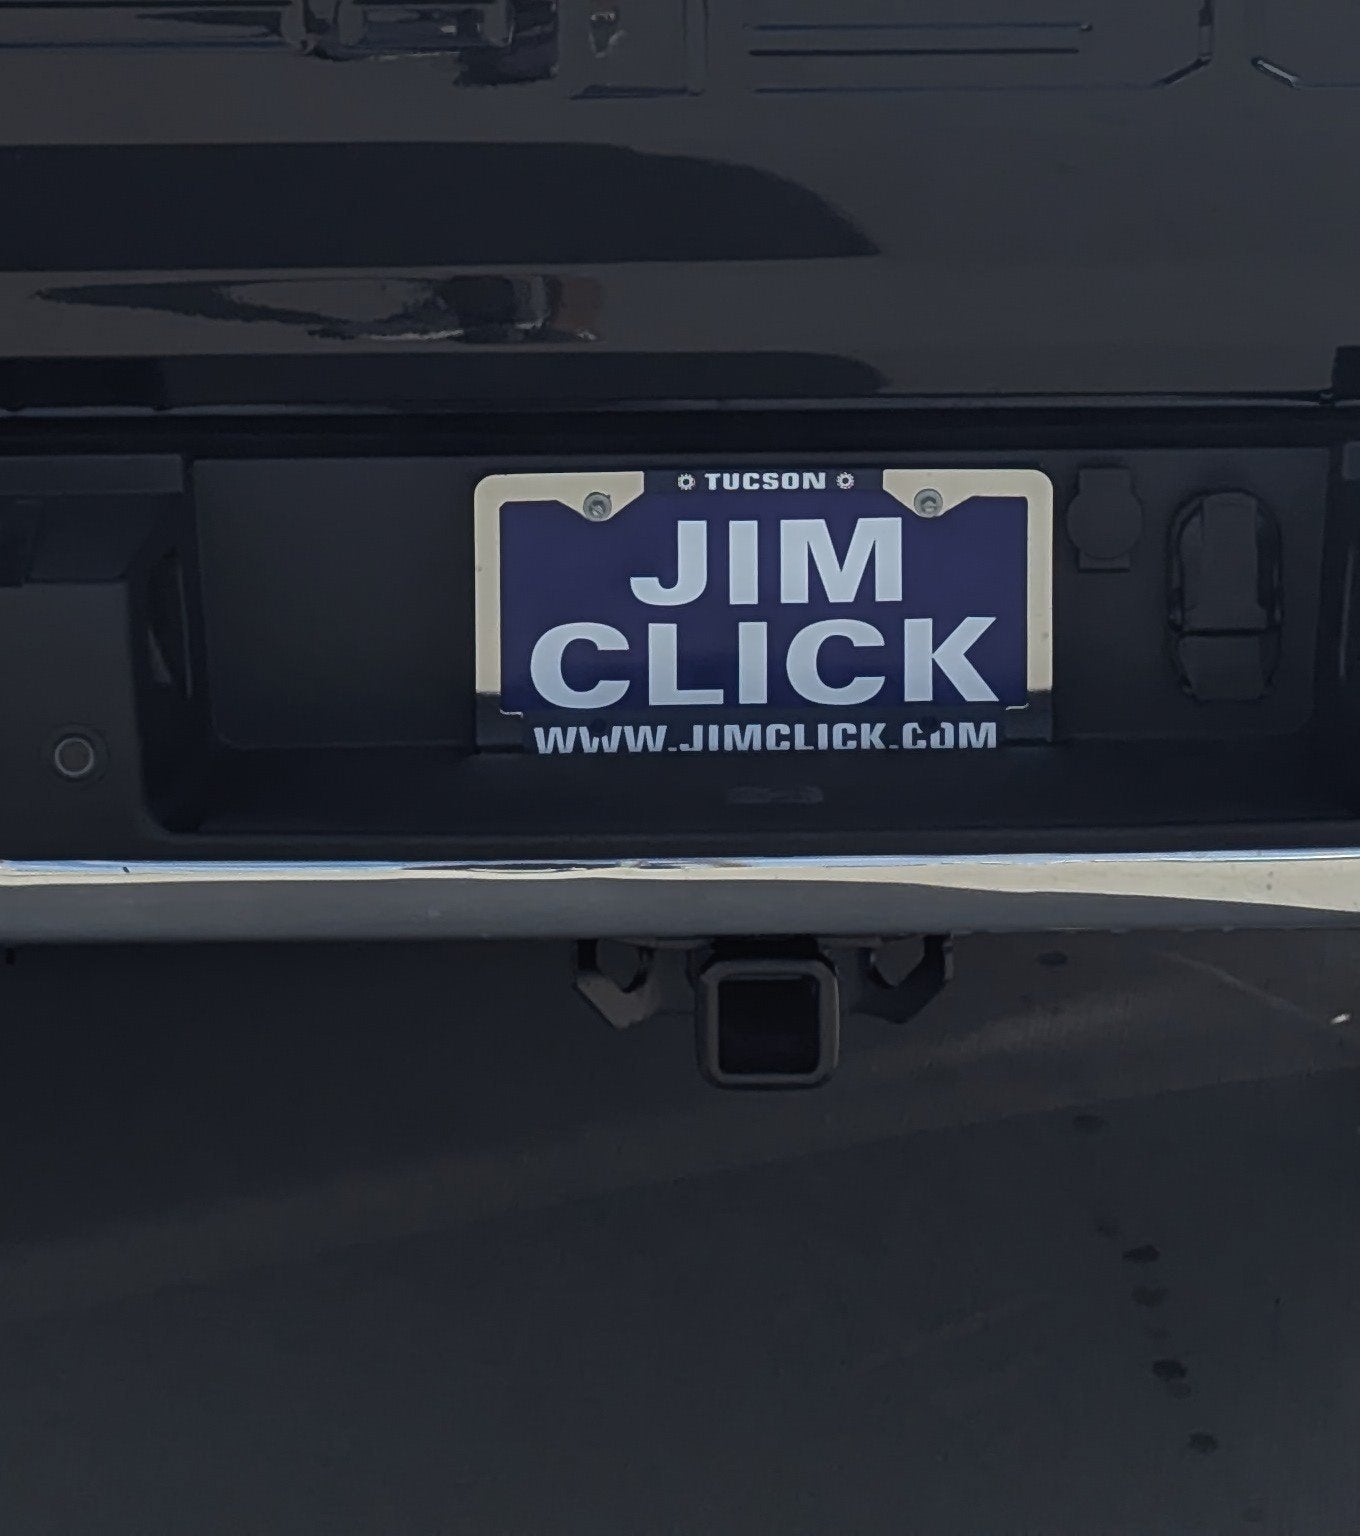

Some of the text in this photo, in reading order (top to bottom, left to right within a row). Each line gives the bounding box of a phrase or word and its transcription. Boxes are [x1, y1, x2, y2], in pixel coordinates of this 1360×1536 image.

[704, 472, 826, 491] TUCSON
[629, 516, 903, 606] JIM
[530, 616, 1000, 709] CLICK
[533, 721, 998, 754] WWW.JIMCLICK.COM
